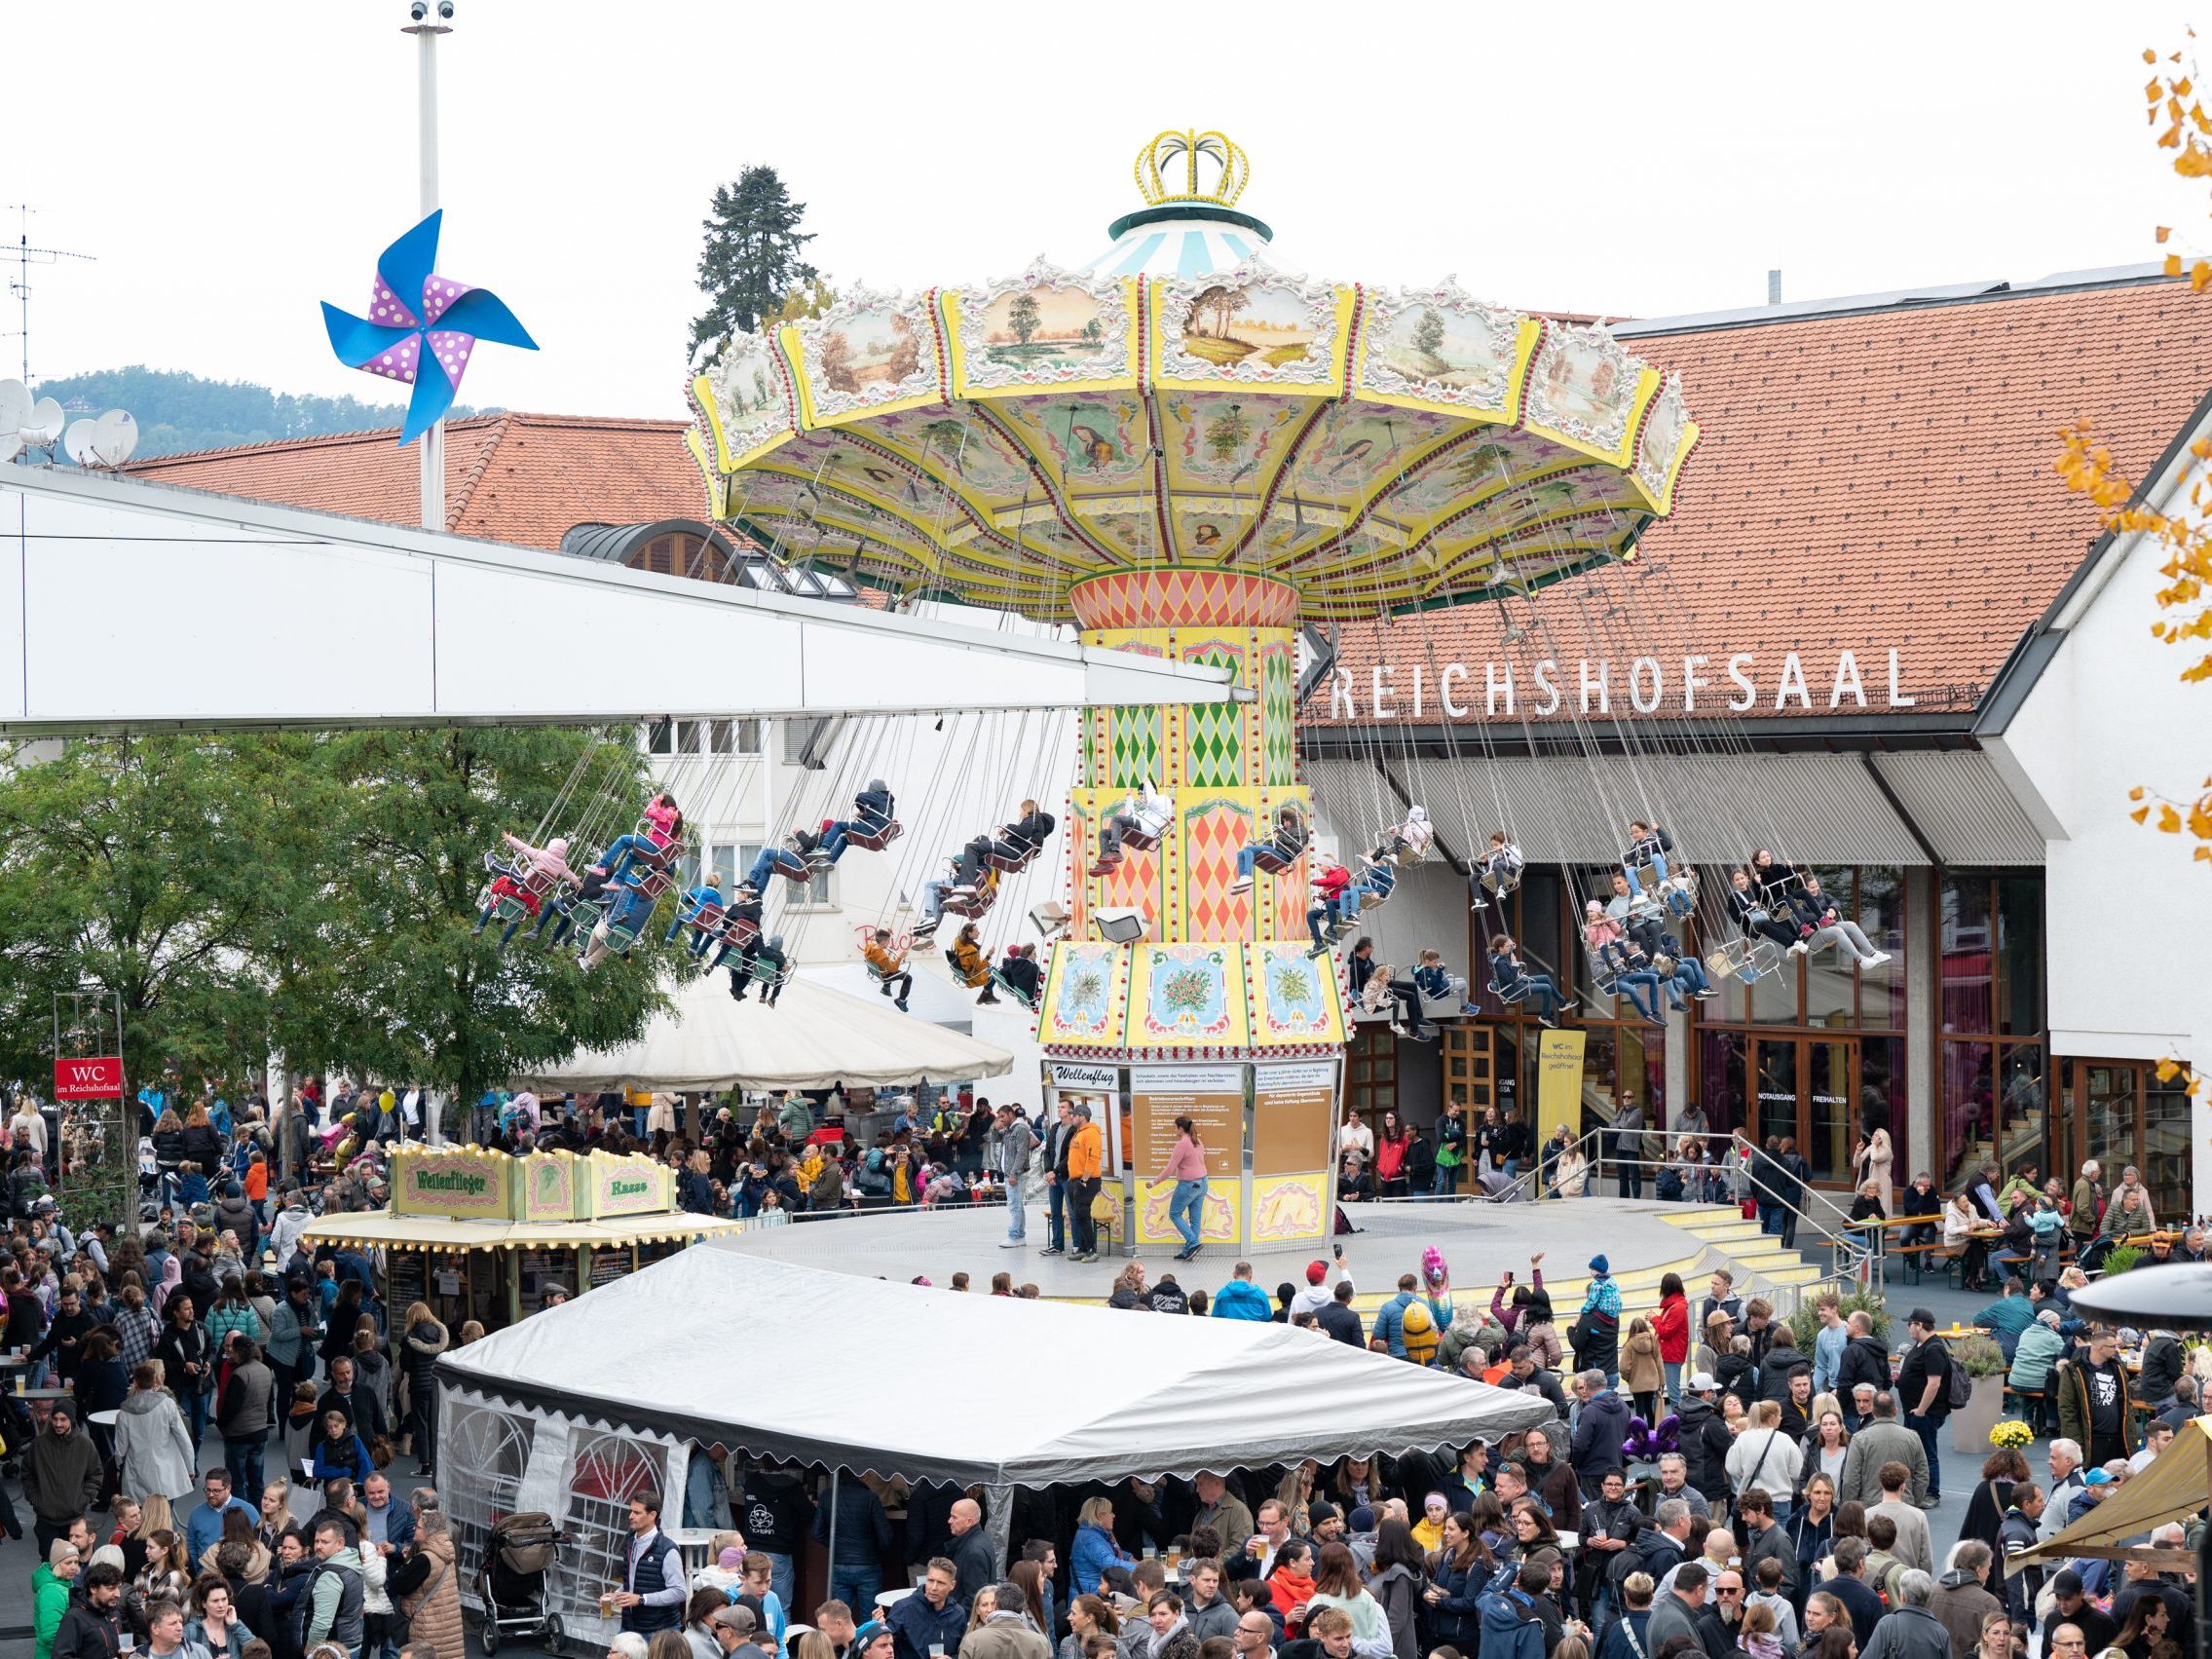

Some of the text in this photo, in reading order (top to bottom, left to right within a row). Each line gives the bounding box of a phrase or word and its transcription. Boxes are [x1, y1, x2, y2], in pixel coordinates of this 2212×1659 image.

[1329, 648, 1916, 720] REICHSHOFSAAL
[71, 1066, 106, 1082] WC
[1056, 1066, 1115, 1086] Wellenflug
[57, 1082, 121, 1093] im Reichshofsaal
[1758, 1093, 1796, 1102] NOTAUSGANG
[1813, 1095, 1847, 1104] FREIHALTEN
[416, 1170, 485, 1195] Wellenflieger
